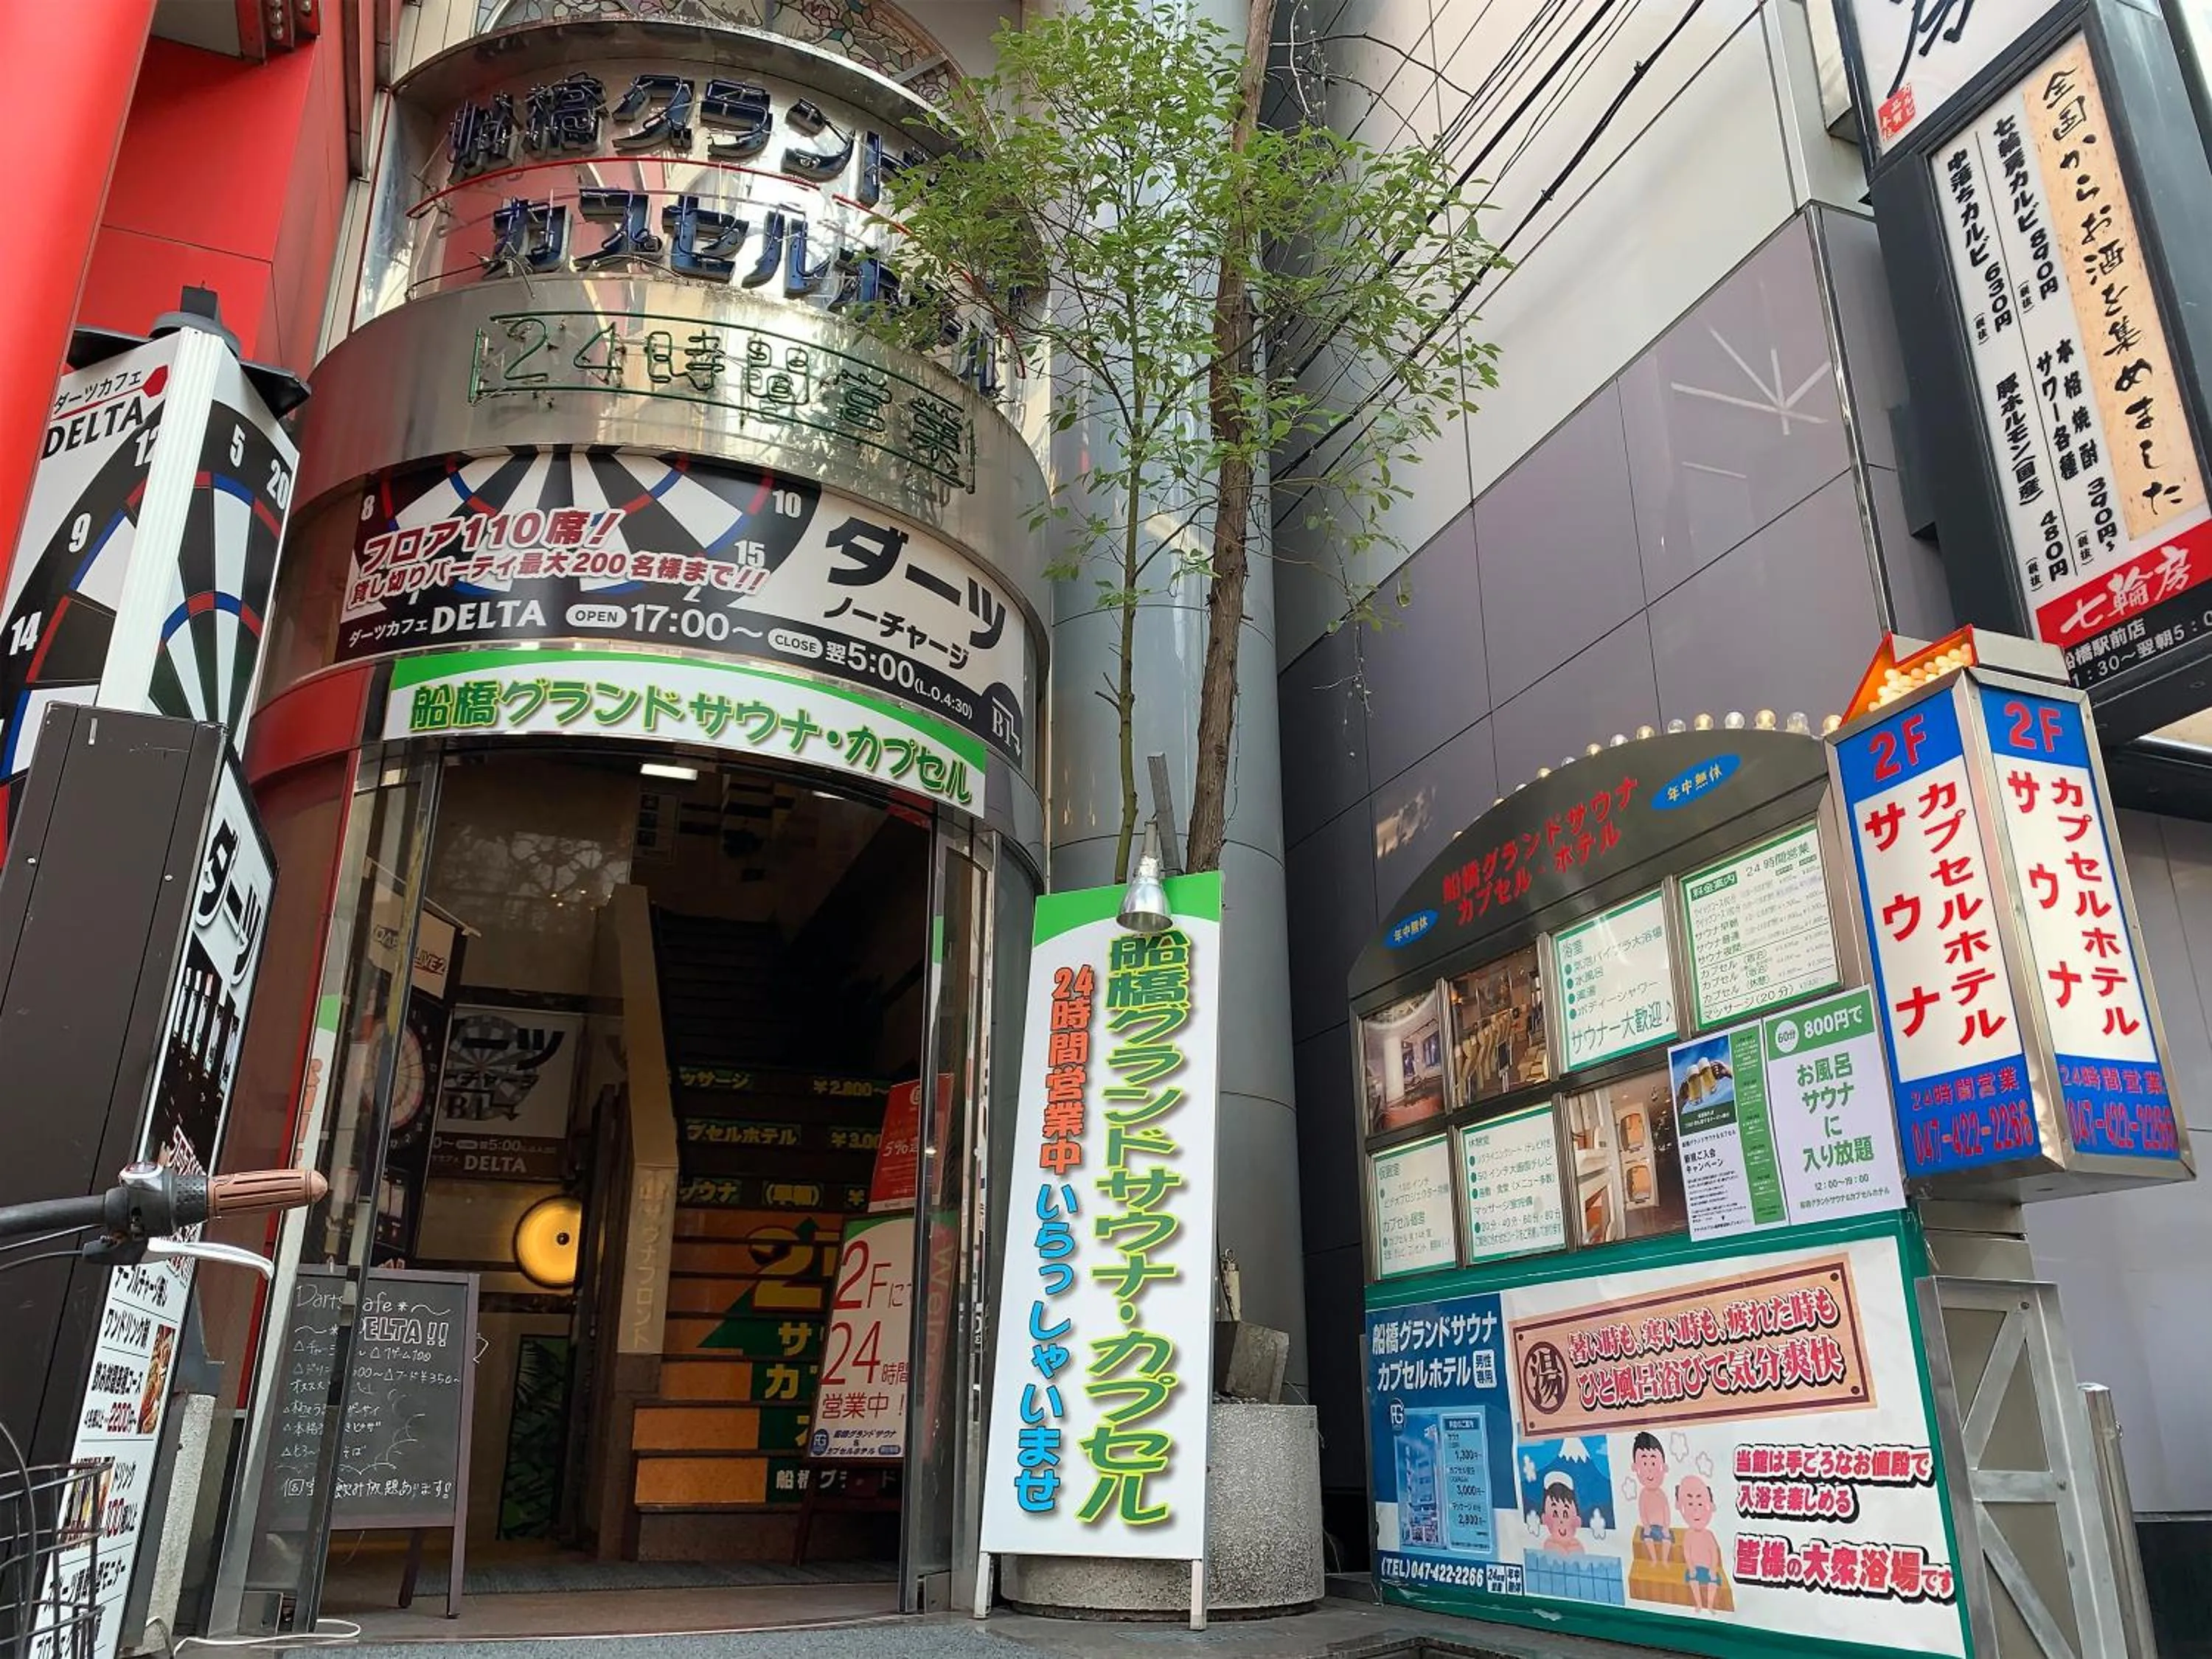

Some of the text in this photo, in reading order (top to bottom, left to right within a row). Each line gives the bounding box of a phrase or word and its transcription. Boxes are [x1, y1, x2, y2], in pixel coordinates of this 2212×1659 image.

[2043, 65, 2183, 515] 全国からお酒を集めました
[54, 369, 142, 414] ダーツカフェ
[41, 396, 145, 460] DELTA
[229, 425, 246, 467] 5
[267, 459, 291, 510] 20
[773, 489, 802, 519] 10
[69, 512, 91, 553] 9
[734, 540, 765, 567] 15
[825, 515, 1007, 650] ダーツ
[2060, 544, 2194, 635] 七輪房
[9, 611, 40, 655] 14
[349, 618, 429, 648] ダーツカフェ
[430, 599, 547, 636] DELTA
[574, 609, 619, 623] OPEN
[774, 633, 818, 654] CLOSE
[824, 597, 971, 671] ノーチャージ
[1868, 713, 1927, 782] 2F
[2004, 700, 2063, 753] 2F
[195, 817, 263, 987] ダーツ
[2006, 771, 2082, 1007] サウナ
[2051, 777, 2140, 1037] カプセルホテル
[1864, 801, 1941, 1038] サウナ
[1918, 782, 2008, 1046] カプセルホテル
[1804, 1005, 1864, 1040] 800円で
[679, 1073, 750, 1089] ッサージ
[1039, 964, 1094, 1176] 24時間営業中
[1797, 1051, 1854, 1088] お風呂
[1910, 1065, 2020, 1111] 24時間営業
[1801, 1081, 1855, 1115] サウナ
[686, 1121, 798, 1146] プセルホテル
[1823, 1115, 1843, 1138] に
[464, 1154, 526, 1173] DELTA
[1686, 1158, 1724, 1175] キャンペーン
[1803, 1135, 1875, 1174] 入り放題
[1014, 1183, 1080, 1513] いらっしゃいませ
[1372, 1311, 1498, 1355] 船橋グランドサウナ
[1377, 1355, 1472, 1391] カプセルホテル
[1529, 1347, 1563, 1405] 湯
[1576, 1335, 1846, 1411] ひと風呂浴びて気分爽快
[1734, 1445, 1933, 1481] 当館は手ごろなお値段で
[1736, 1482, 1854, 1516] 入浴を楽しめる
[1733, 1536, 1955, 1596] 皆様の大衆浴場です
